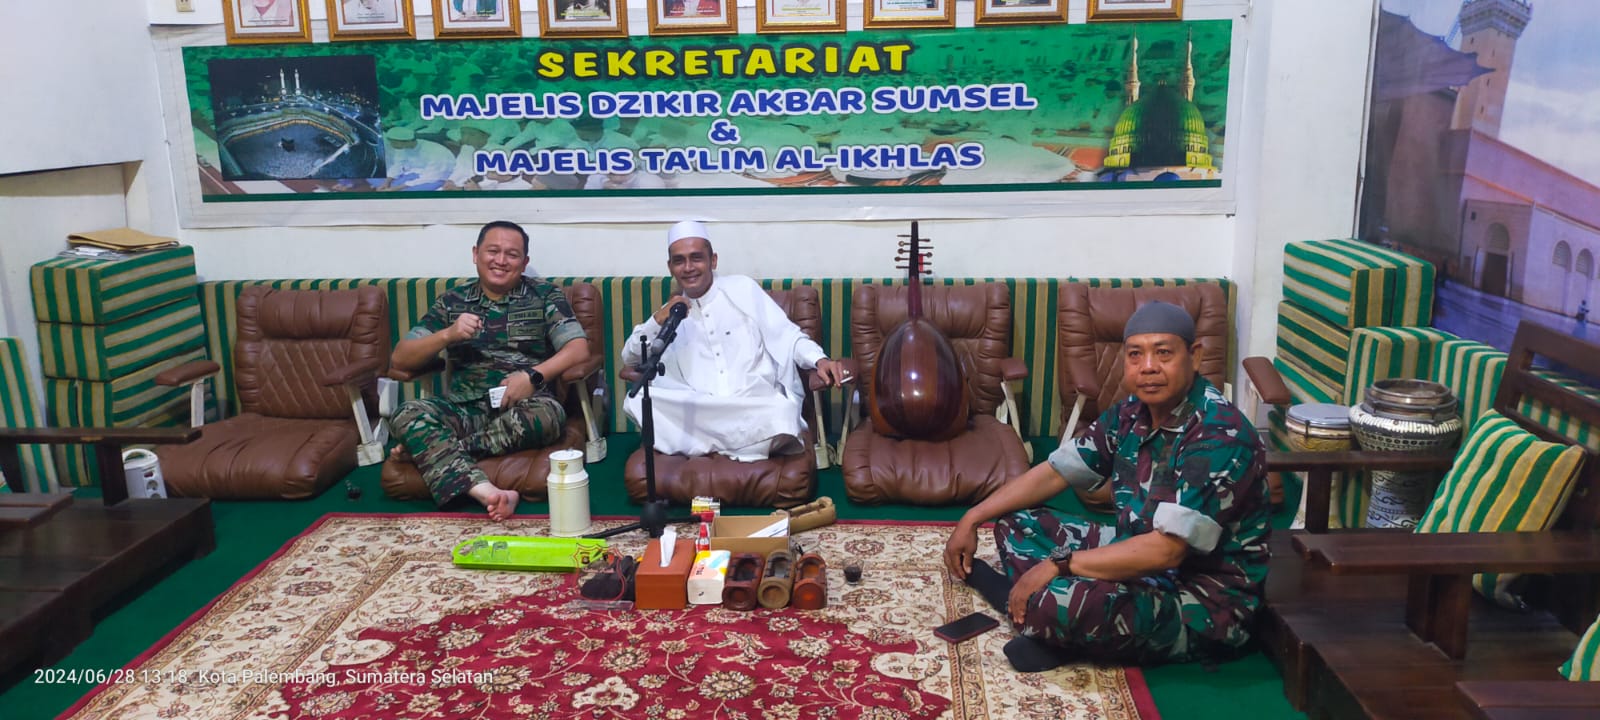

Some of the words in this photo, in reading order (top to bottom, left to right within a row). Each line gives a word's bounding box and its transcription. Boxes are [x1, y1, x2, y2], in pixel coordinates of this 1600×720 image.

[537, 45, 911, 78] SEKRETARIAT
[422, 95, 581, 117] MAJELIS
[592, 93, 720, 115] DZIKIR
[730, 91, 863, 113] AKBAR
[874, 86, 1035, 109] SUMSEL
[710, 120, 738, 142] &
[476, 151, 633, 172] MAJELIS
[642, 149, 765, 171] TA'LIM
[776, 146, 983, 169] AL-IKHLAS
